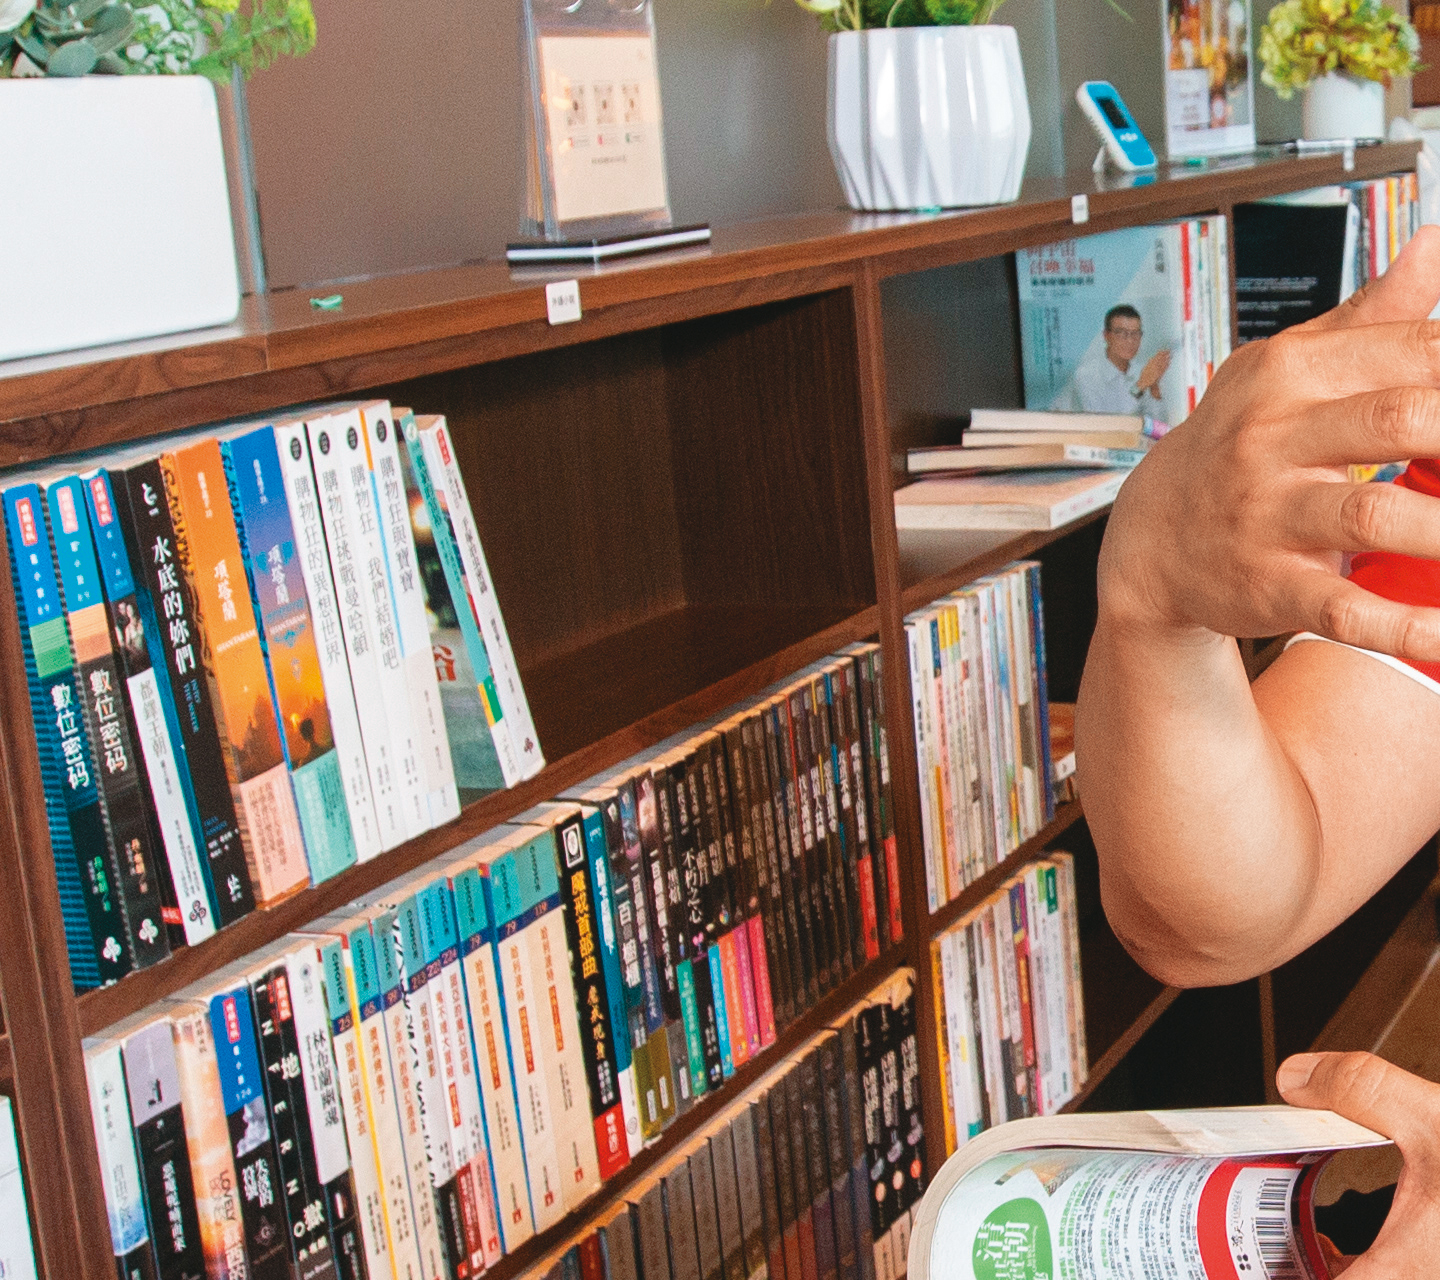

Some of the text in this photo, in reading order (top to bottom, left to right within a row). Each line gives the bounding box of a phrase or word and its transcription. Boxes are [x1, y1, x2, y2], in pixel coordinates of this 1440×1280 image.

[213, 558, 238, 622] 項塔蘭
[267, 543, 291, 606] 項塔蘭
[293, 474, 342, 668] 購物狂的異想世界
[322, 468, 369, 657] 購物狂挑戰曼哈頓
[379, 455, 415, 594] 購物狂與寶寶
[151, 535, 196, 676] 水底的妳們
[570, 871, 599, 983] 魔戒首部曲
